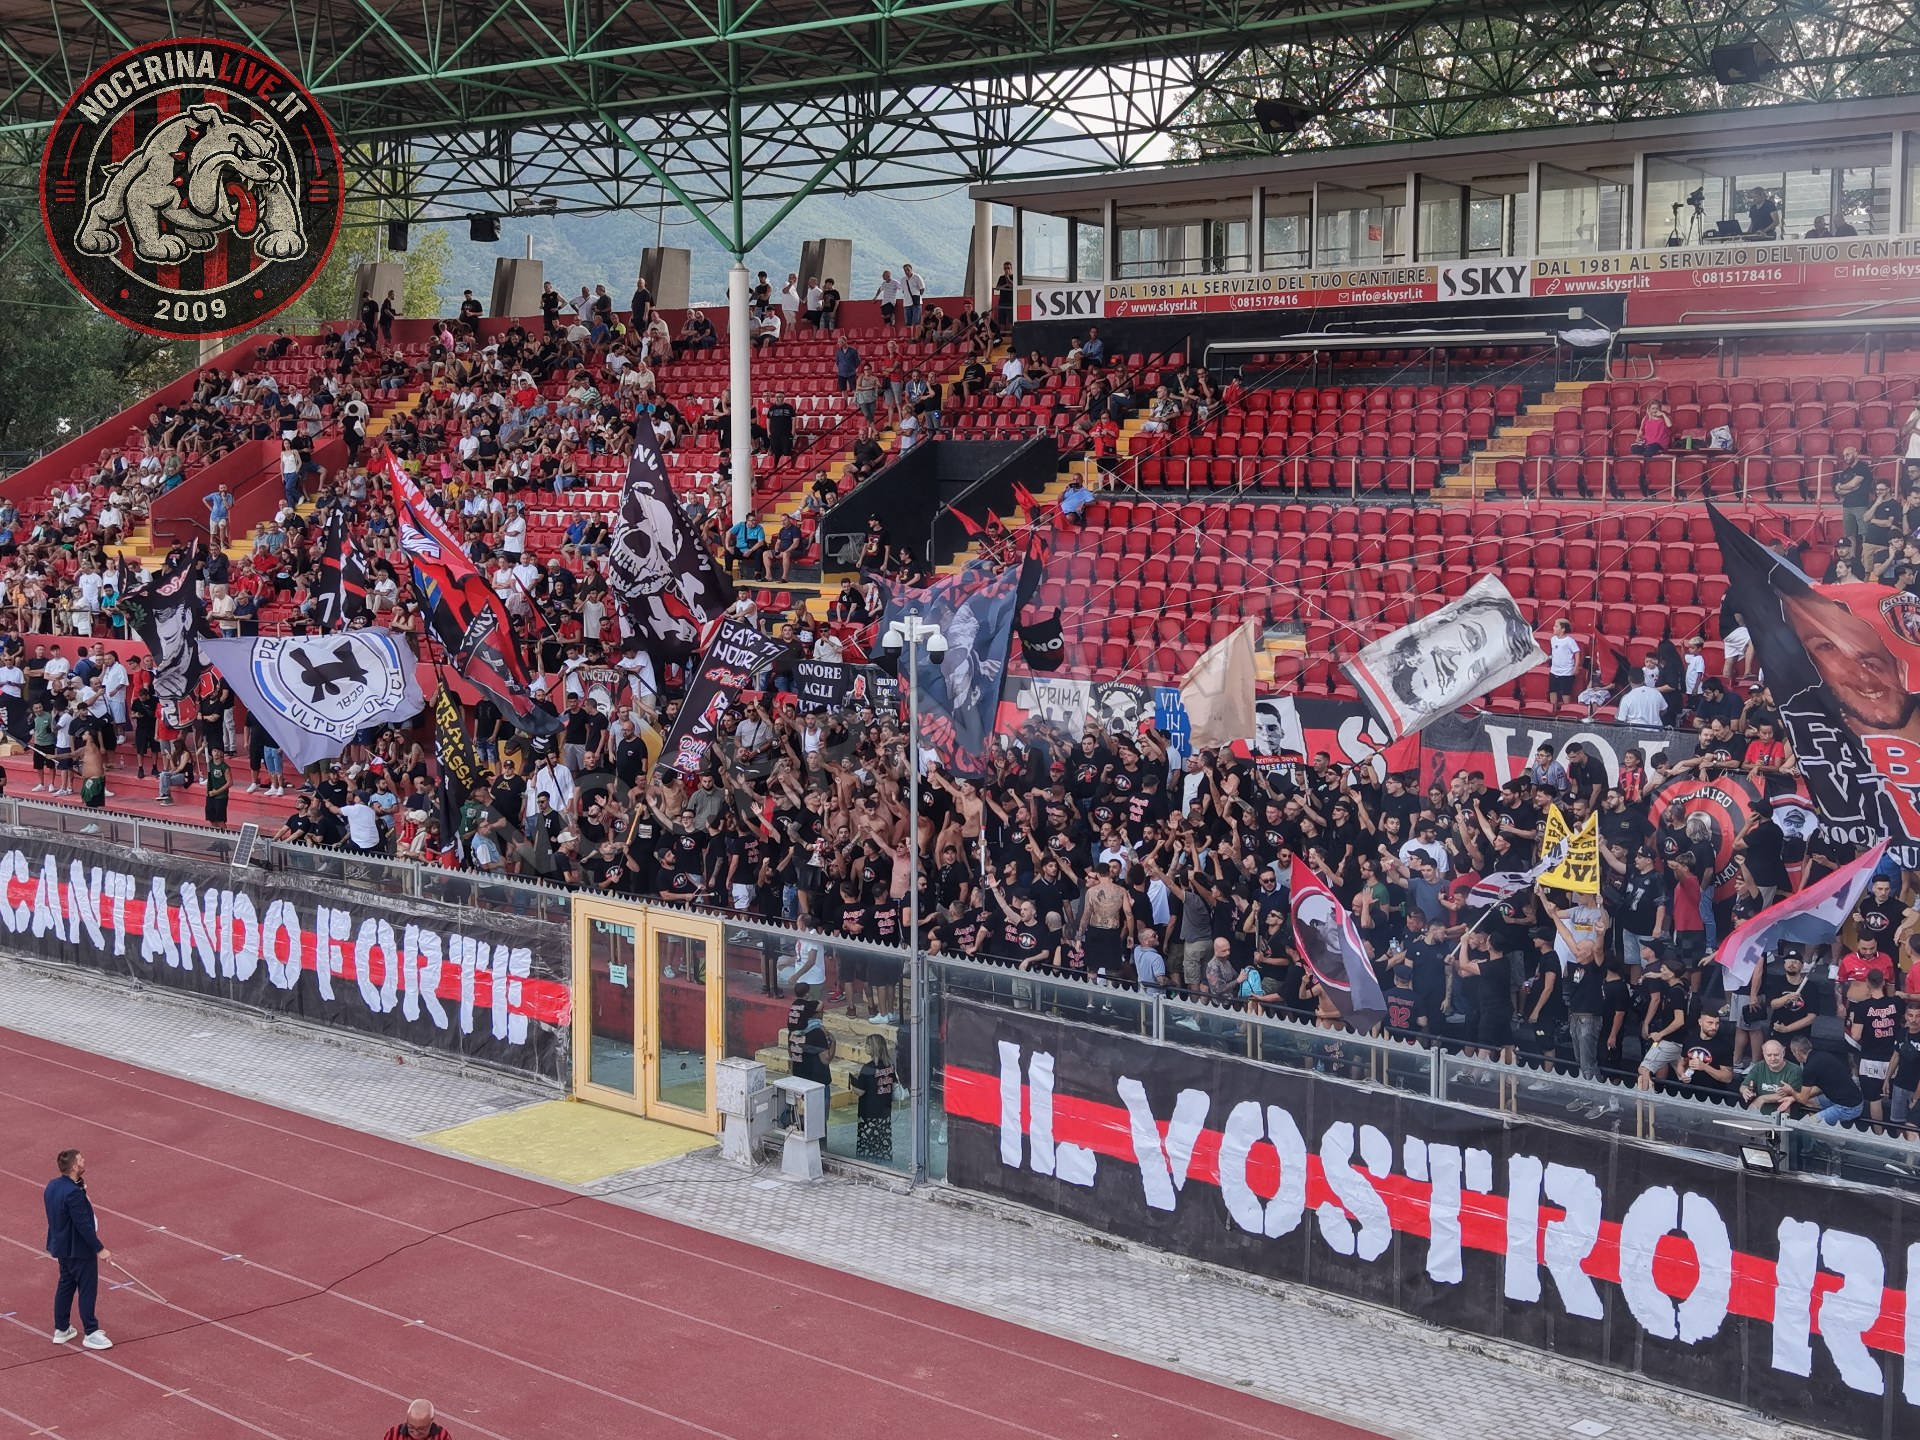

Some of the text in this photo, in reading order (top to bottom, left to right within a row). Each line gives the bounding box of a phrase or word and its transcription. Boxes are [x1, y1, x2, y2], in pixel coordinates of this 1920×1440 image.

[1537, 260, 1571, 276] DAL
[1579, 257, 1621, 274] 1981
[1631, 255, 1651, 271] AL
[1659, 250, 1746, 269] SERVIZIO
[1756, 246, 1792, 263] DEL
[1800, 244, 1839, 261] TUO
[1109, 267, 1432, 299] DAL 1981 AL SERVIZIO DEL TUO CANTIERE.
[1564, 274, 1650, 292] www.skysrl.it
[1702, 269, 1782, 284] 0815178416
[1236, 295, 1298, 309] 0815178416
[1351, 288, 1423, 303] info@skysrl.it
[1130, 300, 1198, 315] www.skysrl.it
[798, 663, 842, 680] ONORE
[803, 682, 834, 698] AGLI
[876, 678, 898, 687] SILVIO
[1038, 685, 1081, 707] PRIMA
[1160, 692, 1186, 712] VIV
[1166, 713, 1181, 731] IN
[1171, 732, 1185, 752] OI
[0, 850, 533, 1046] CANTANDO FORTE
[1389, 1005, 1410, 1028] 92
[998, 1040, 1920, 1407] IL VOSTRO R
